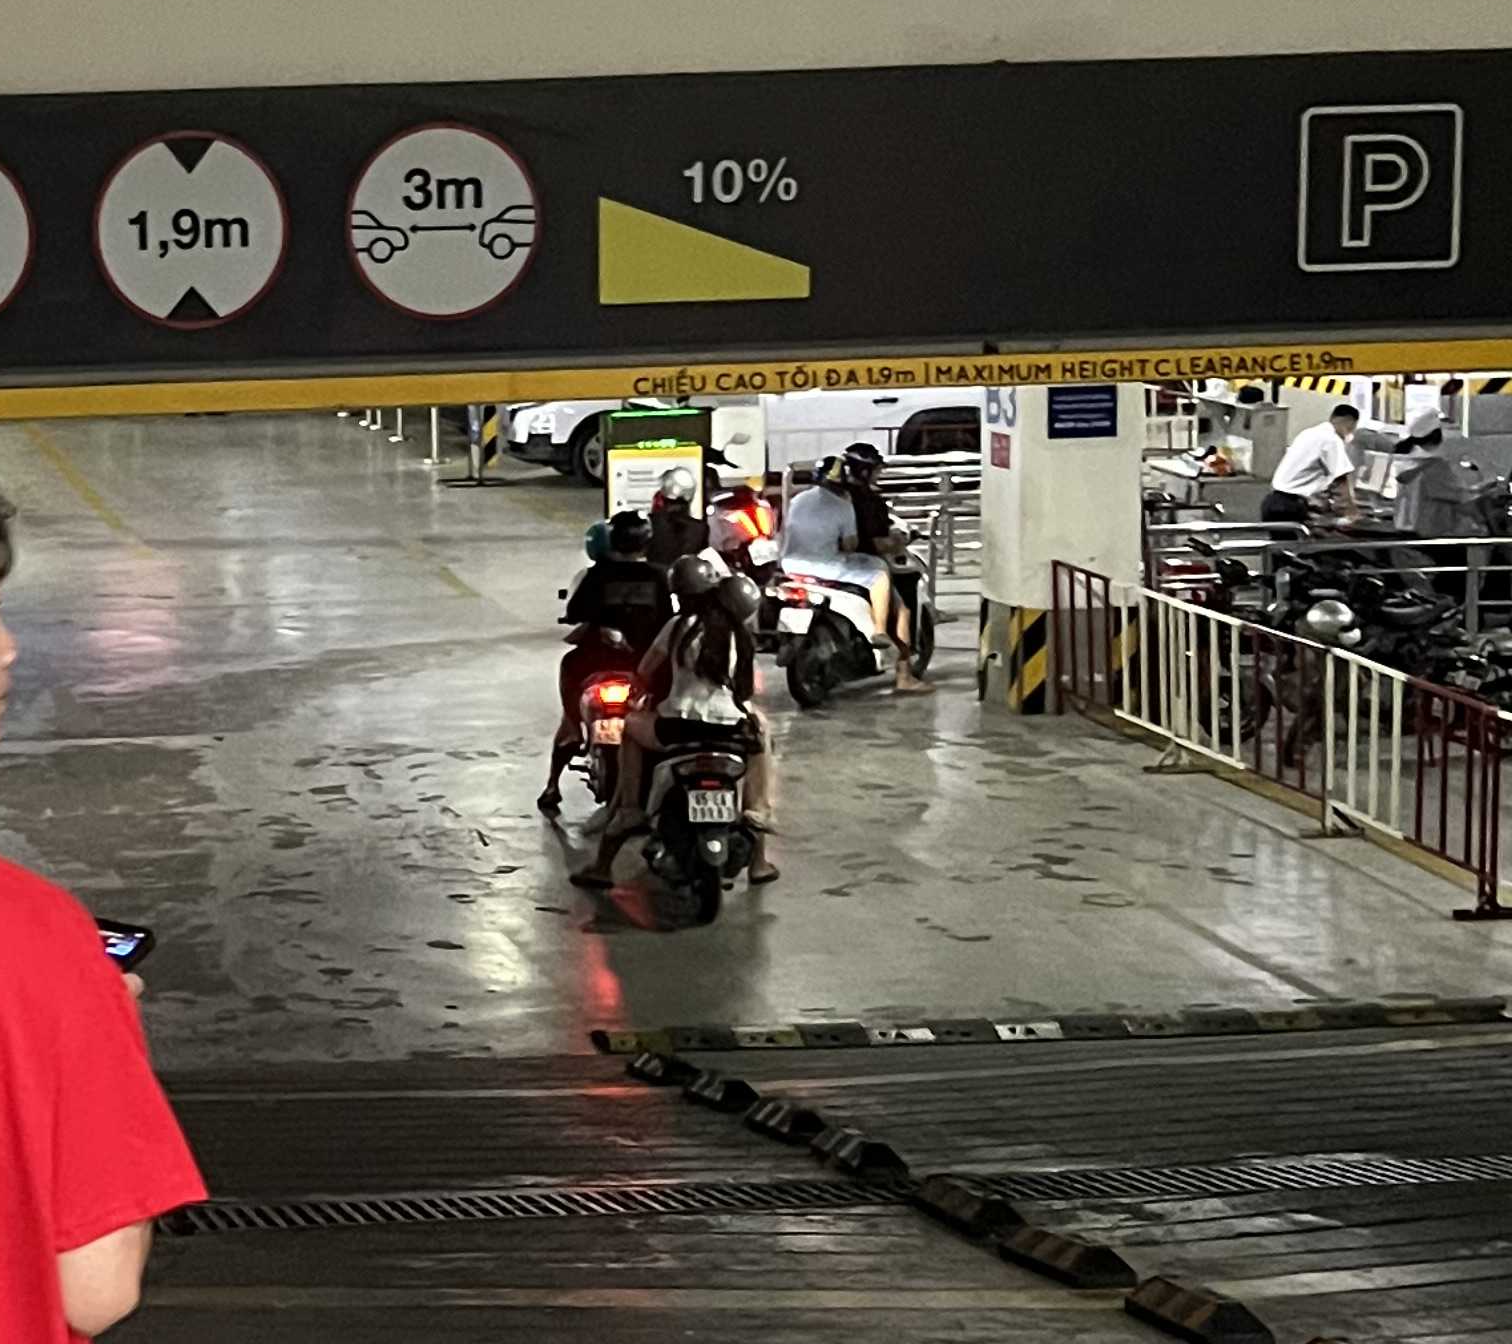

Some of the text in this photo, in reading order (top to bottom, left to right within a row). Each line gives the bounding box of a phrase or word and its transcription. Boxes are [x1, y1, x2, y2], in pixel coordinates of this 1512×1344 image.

[402, 167, 484, 213] 3m
[682, 157, 799, 205] 10%
[1342, 133, 1430, 249] P
[127, 208, 251, 259] 1,9m
[715, 371, 767, 391] CAO
[825, 367, 860, 387] ĐA
[936, 362, 1052, 384] MAXIMUM
[1061, 358, 1148, 379] HEIGHT
[1153, 353, 1302, 377] CLEARANCE
[1305, 351, 1354, 372] 1.9m
